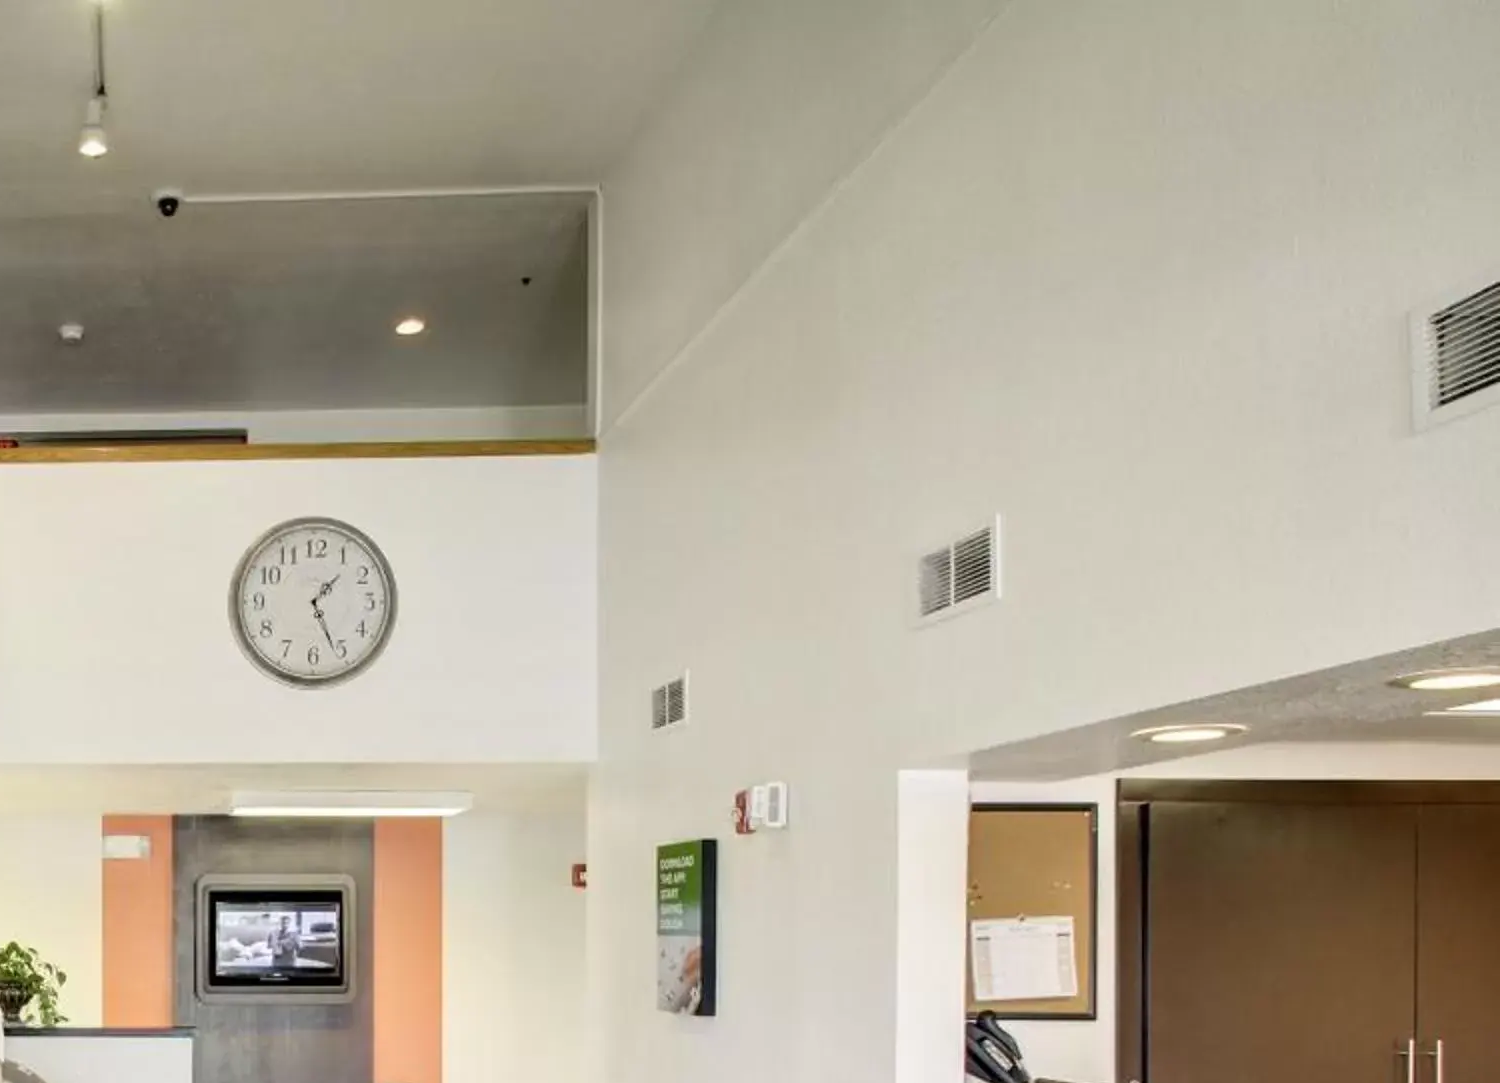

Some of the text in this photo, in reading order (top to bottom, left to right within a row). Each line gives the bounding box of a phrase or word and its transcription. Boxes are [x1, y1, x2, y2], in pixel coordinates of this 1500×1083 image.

[280, 546, 297, 565] 11
[306, 539, 327, 558] 12
[260, 566, 281, 585] 10
[356, 565, 369, 585] 2
[253, 592, 265, 610] 9
[364, 592, 375, 611] 3
[259, 620, 273, 638] 8
[355, 620, 368, 638] 4
[280, 639, 293, 658] 7
[307, 646, 319, 665] 6
[335, 639, 347, 658] 5
